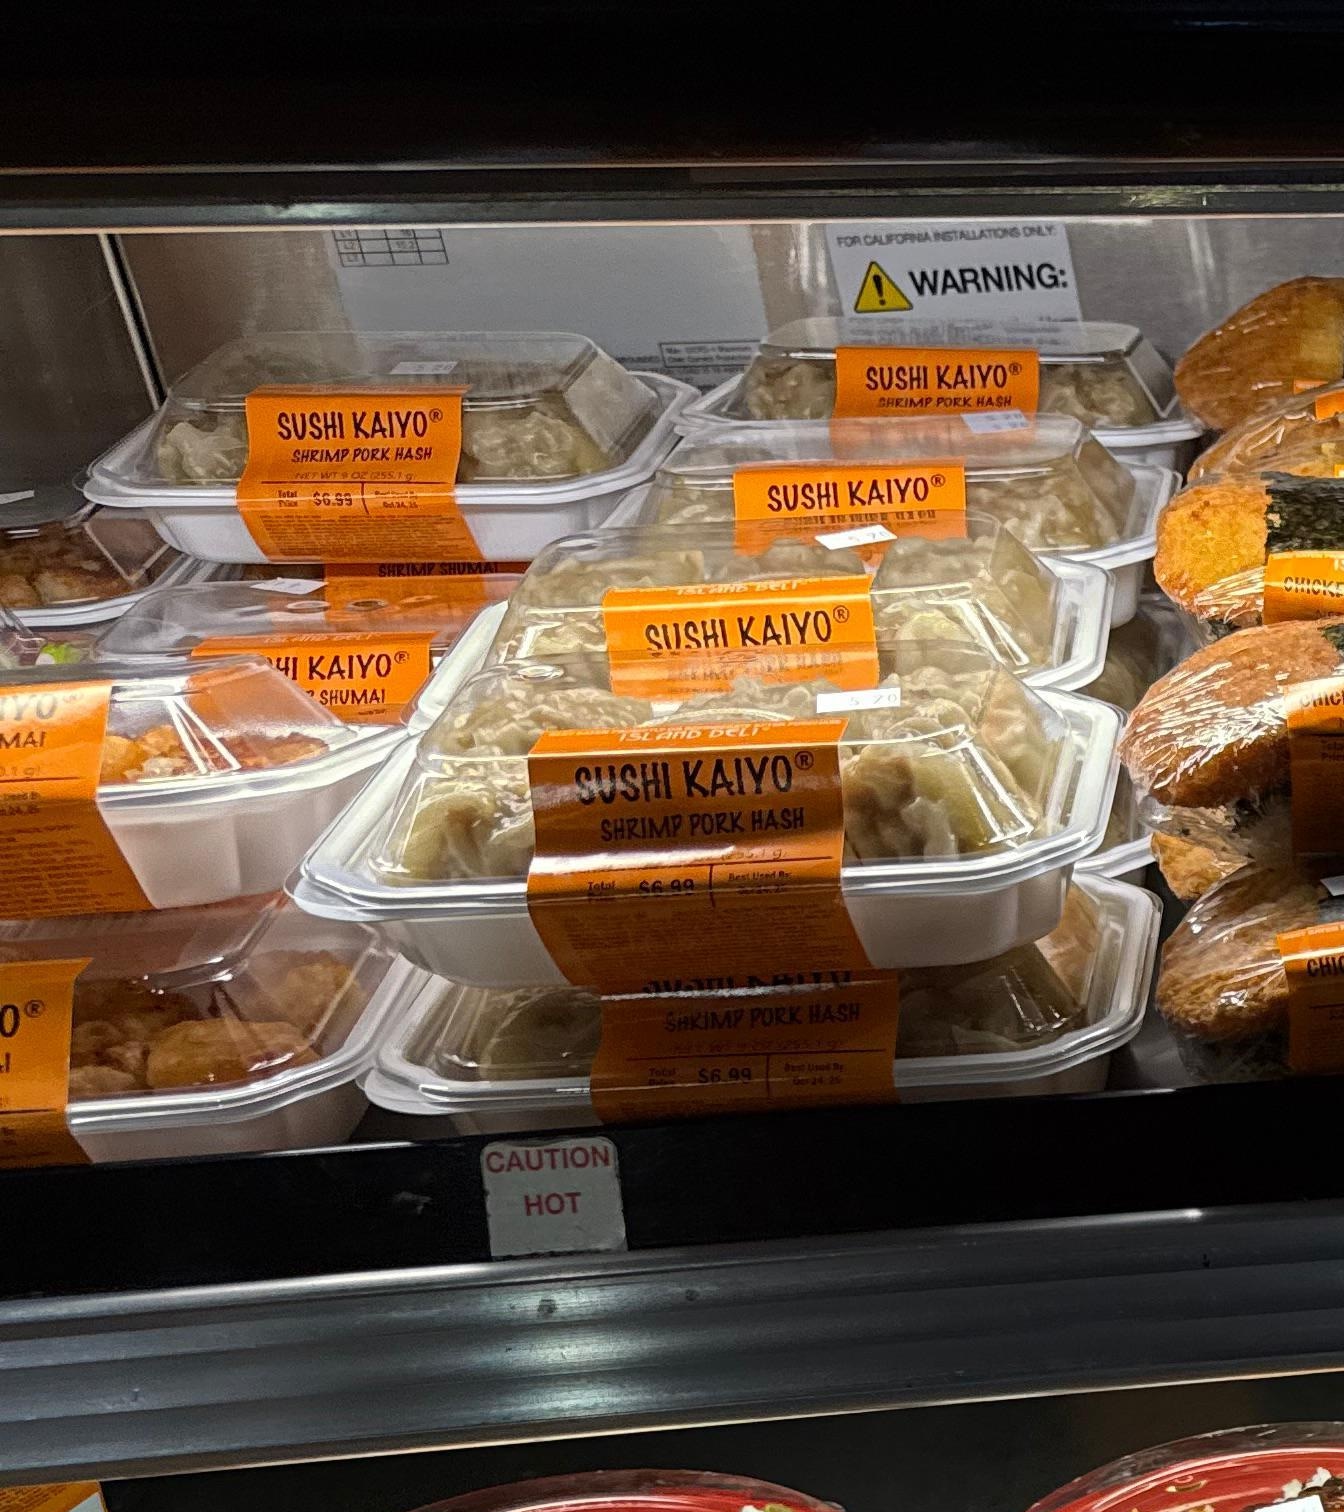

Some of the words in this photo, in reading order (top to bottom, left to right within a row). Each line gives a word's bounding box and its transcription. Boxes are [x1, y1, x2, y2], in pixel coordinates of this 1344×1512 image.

[909, 262, 1069, 298] WARNING:
[866, 364, 929, 391] SUSHI
[277, 410, 345, 441] SUSHI
[292, 447, 347, 463] SHRIMP
[349, 446, 391, 462] PORK
[395, 445, 433, 461] HASH
[767, 484, 841, 512] SUSHI
[320, 687, 387, 706] SHUMAI
[575, 764, 671, 807] SUSHI
[600, 817, 682, 842] SHRIMP
[689, 812, 745, 836] PORK
[752, 807, 805, 831] HASH
[665, 1009, 744, 1033] SHRIMP
[749, 1005, 803, 1028] PORK
[808, 1002, 861, 1024] HASH
[486, 1146, 610, 1175] CAUTION
[524, 1192, 581, 1217] HOT
